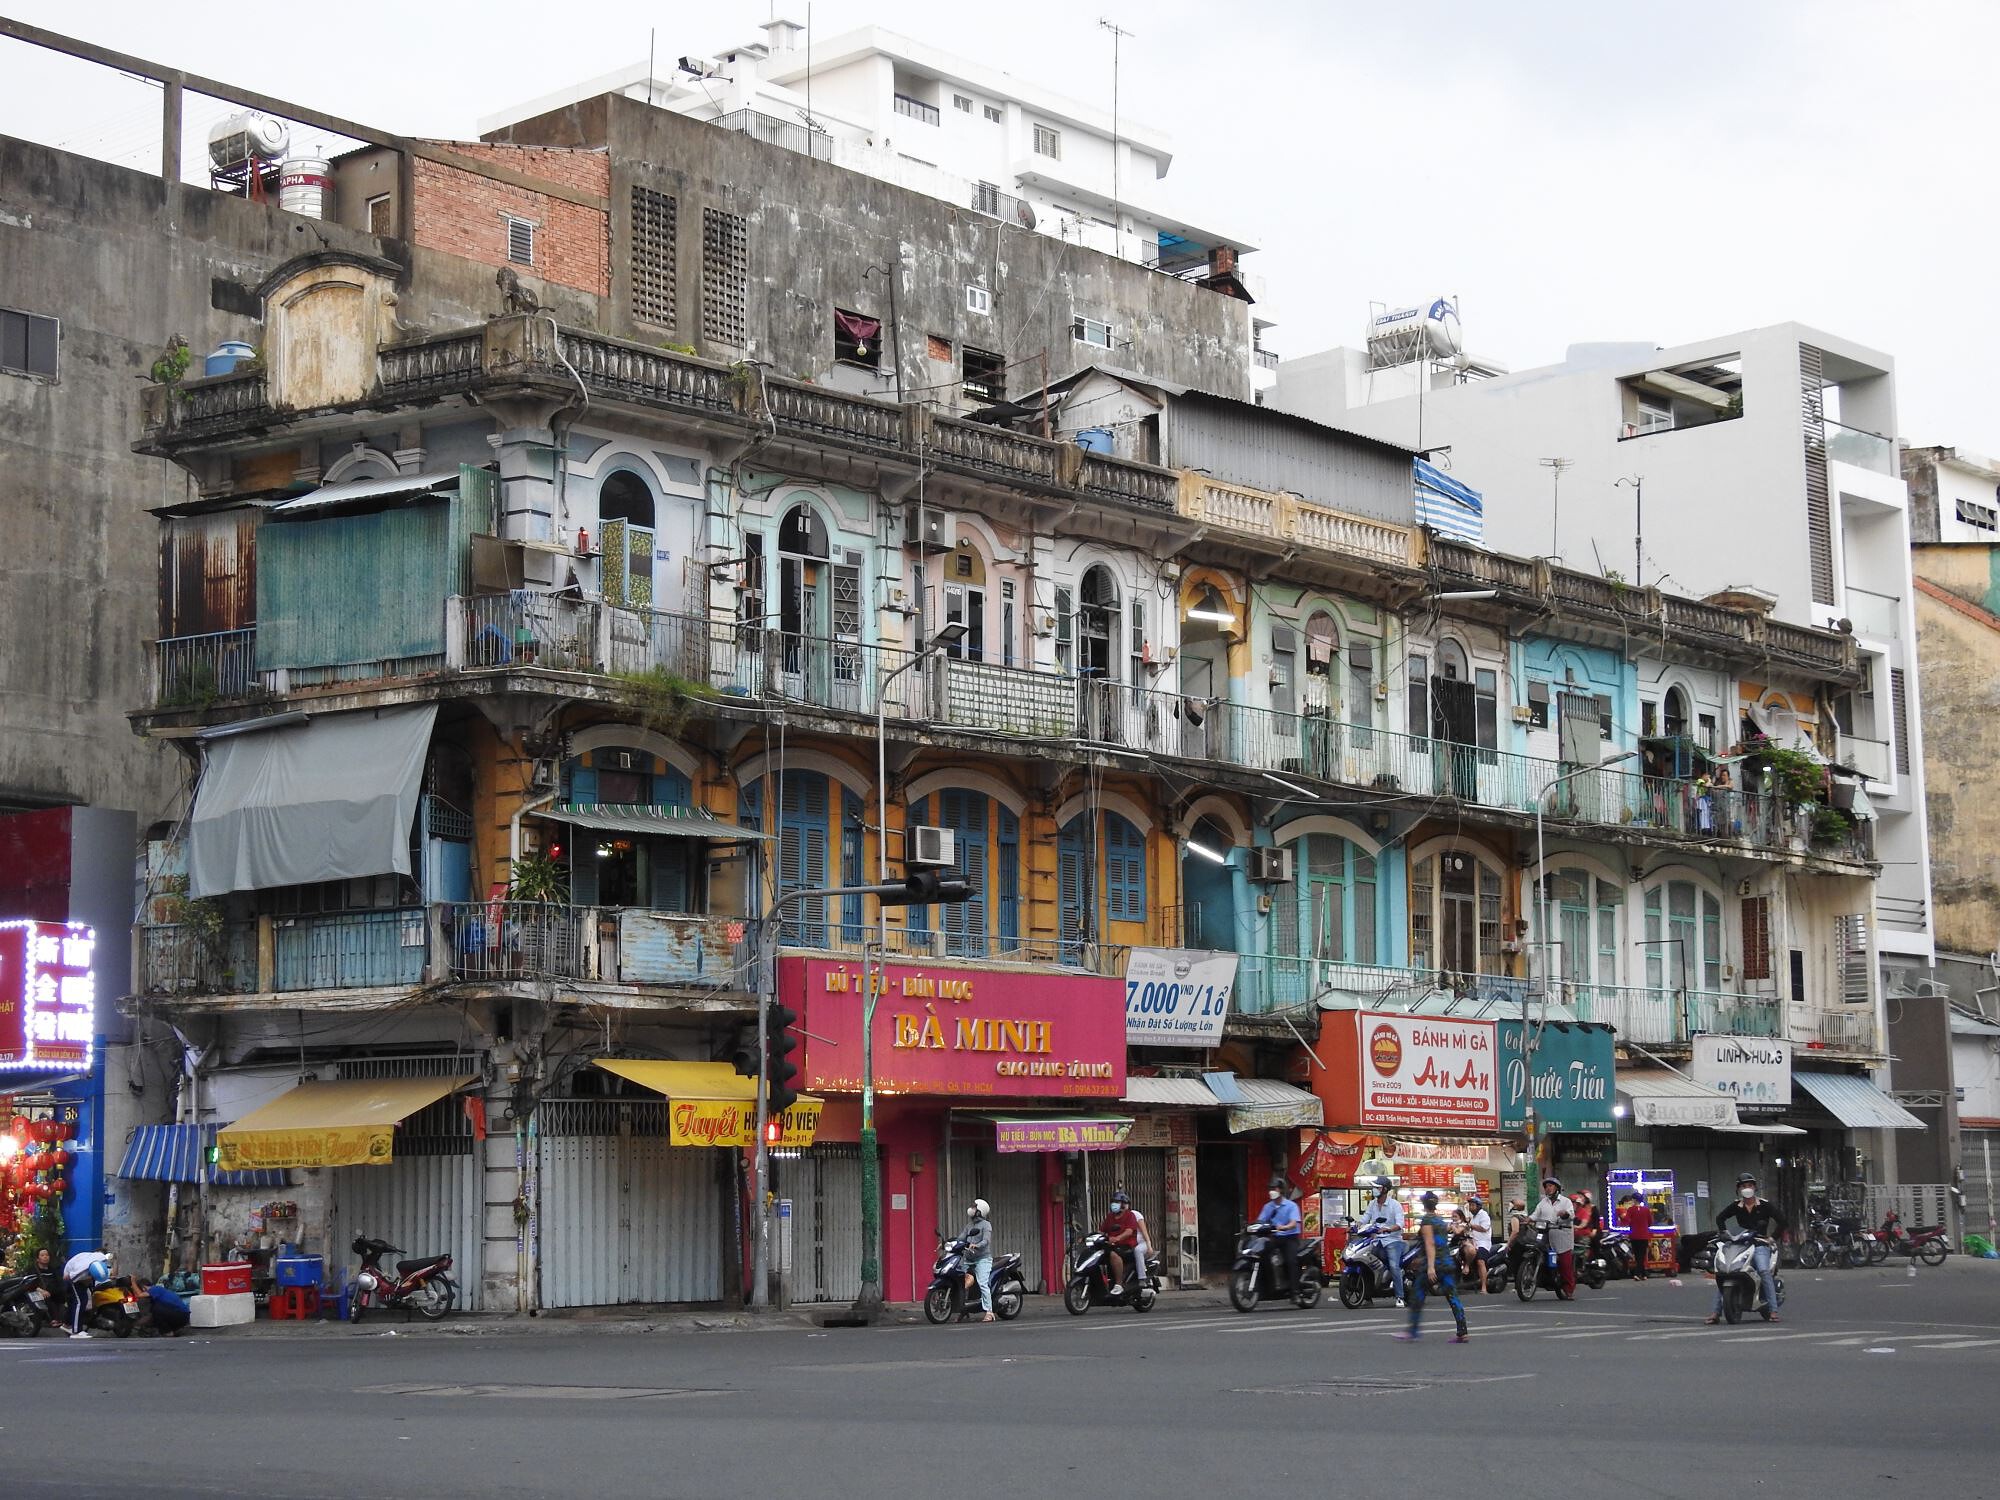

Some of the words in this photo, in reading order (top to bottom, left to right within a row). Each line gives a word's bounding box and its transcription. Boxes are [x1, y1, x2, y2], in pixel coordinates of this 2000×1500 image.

[853, 967, 889, 995] TẾU
[903, 973, 936, 998] BÚN
[939, 980, 974, 1004] MỌC
[1126, 981, 1179, 1014] 7.000
[1180, 984, 1194, 996] VND
[893, 1002, 947, 1049] BÀ
[954, 1017, 1053, 1053] MINH
[1127, 1017, 1146, 1031] Nhận
[1163, 1017, 1173, 1029] Số
[1174, 1019, 1198, 1032] Lượng
[1413, 1026, 1448, 1048] BÁNH
[1453, 1029, 1467, 1050] MÌ
[1470, 1030, 1488, 1051] GÀ
[1717, 1047, 1742, 1064] LINH
[997, 1061, 1030, 1076] GIAO
[1413, 1055, 1450, 1089] An
[1454, 1058, 1489, 1091] An
[1372, 1080, 1386, 1088] Since
[1386, 1081, 1402, 1090] 2009
[1377, 1095, 1394, 1104] BÁNH
[1422, 1097, 1439, 1106] BÁNH
[1440, 1099, 1451, 1107] BAO
[1456, 1099, 1473, 1108] BÁNH
[65, 1107, 77, 1120] 58
[675, 1103, 738, 1144] Tuyết
[1058, 1126, 1078, 1143] Bà
[1081, 1126, 1115, 1143] Minh
